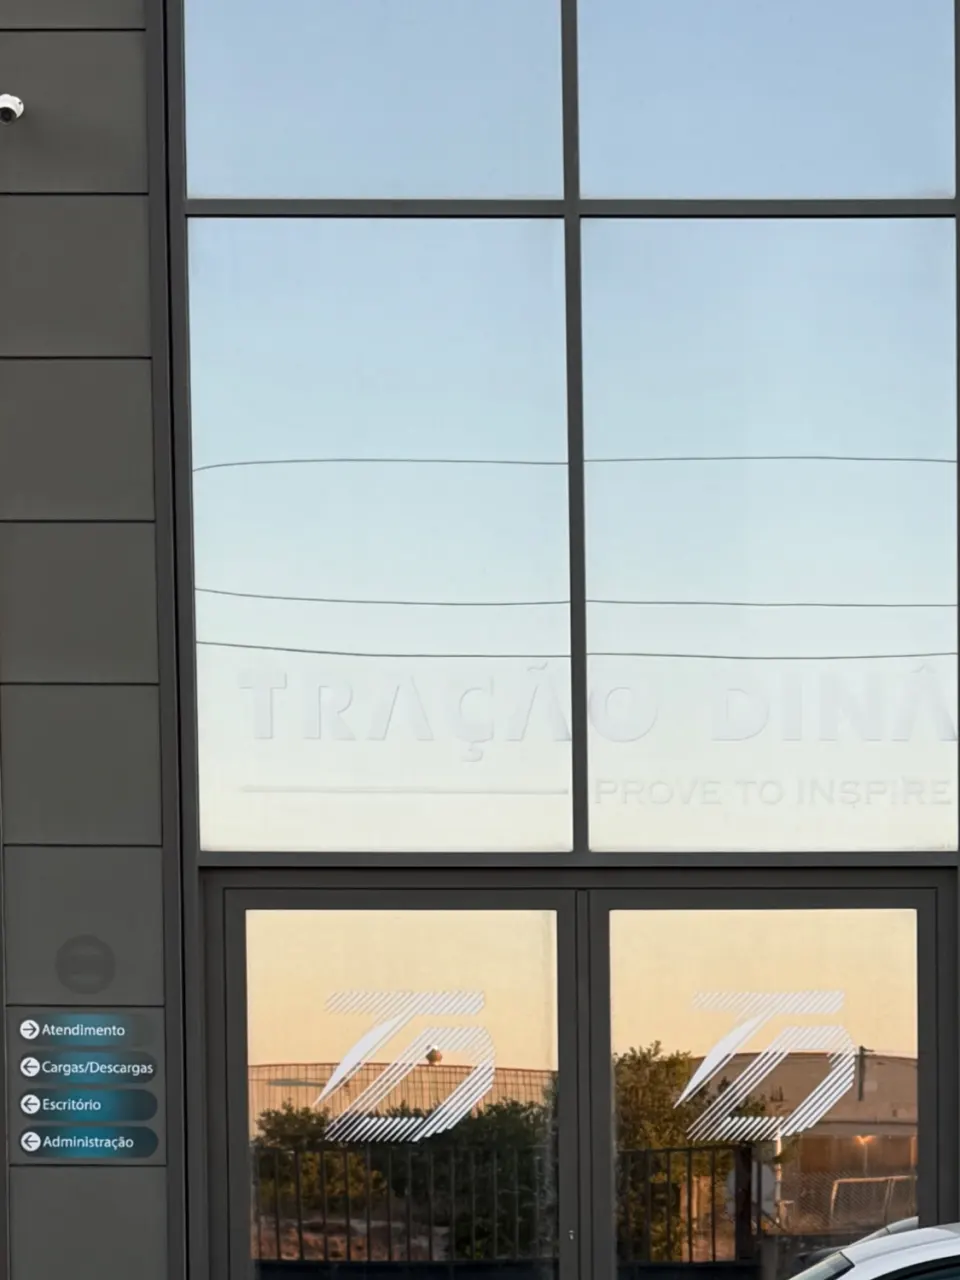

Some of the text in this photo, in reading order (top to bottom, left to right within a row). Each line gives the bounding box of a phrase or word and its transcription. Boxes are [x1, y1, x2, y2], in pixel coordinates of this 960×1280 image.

[237, 661, 660, 763] TRAÇÃO
[593, 777, 953, 807] PROVE TO INSPIRE
[42, 1024, 126, 1037] Atendimento
[42, 1061, 154, 1076] Cargas/Descargas
[42, 1098, 102, 1111] Escritório
[43, 1136, 134, 1150] Administração
